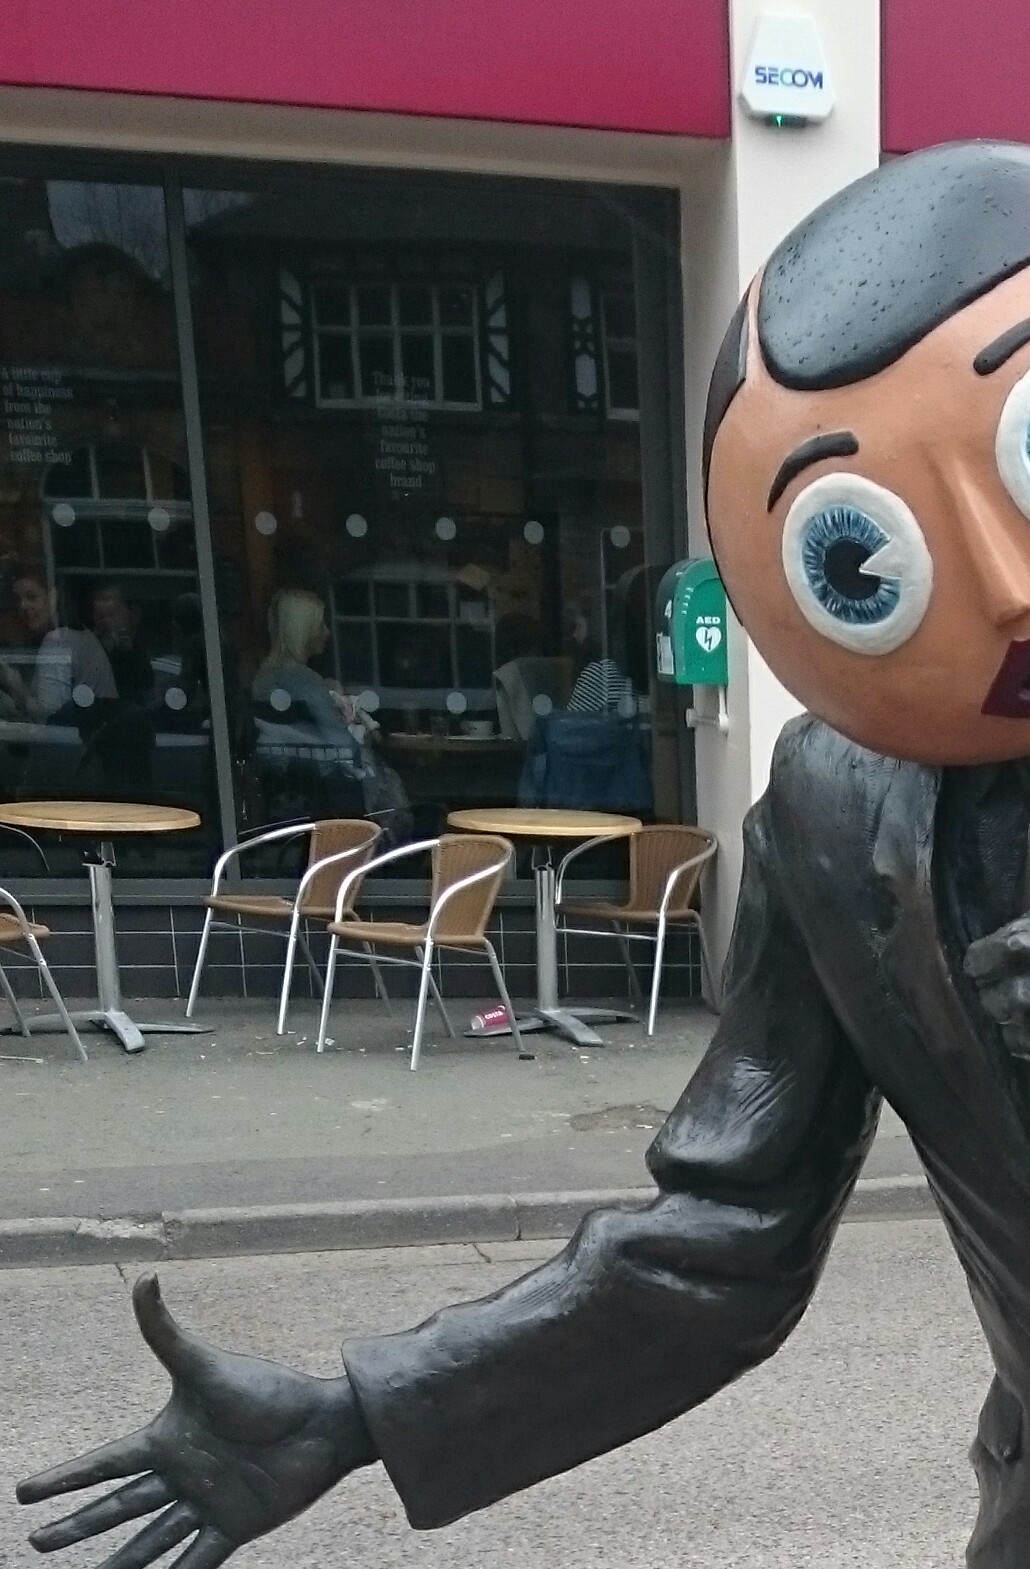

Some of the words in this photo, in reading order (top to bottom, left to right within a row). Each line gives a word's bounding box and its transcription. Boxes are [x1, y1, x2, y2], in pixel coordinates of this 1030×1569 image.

[755, 66, 823, 89] SECOM
[16, 383, 73, 399] happiness
[4, 400, 31, 414] from
[379, 439, 429, 456] favourite
[10, 448, 42, 463] coffee
[44, 449, 73, 466] shop
[374, 456, 407, 471] coffee
[409, 457, 436, 476] shop
[389, 472, 422, 488] brand
[696, 616, 721, 625] AED
[485, 1010, 504, 1020] COSTA
